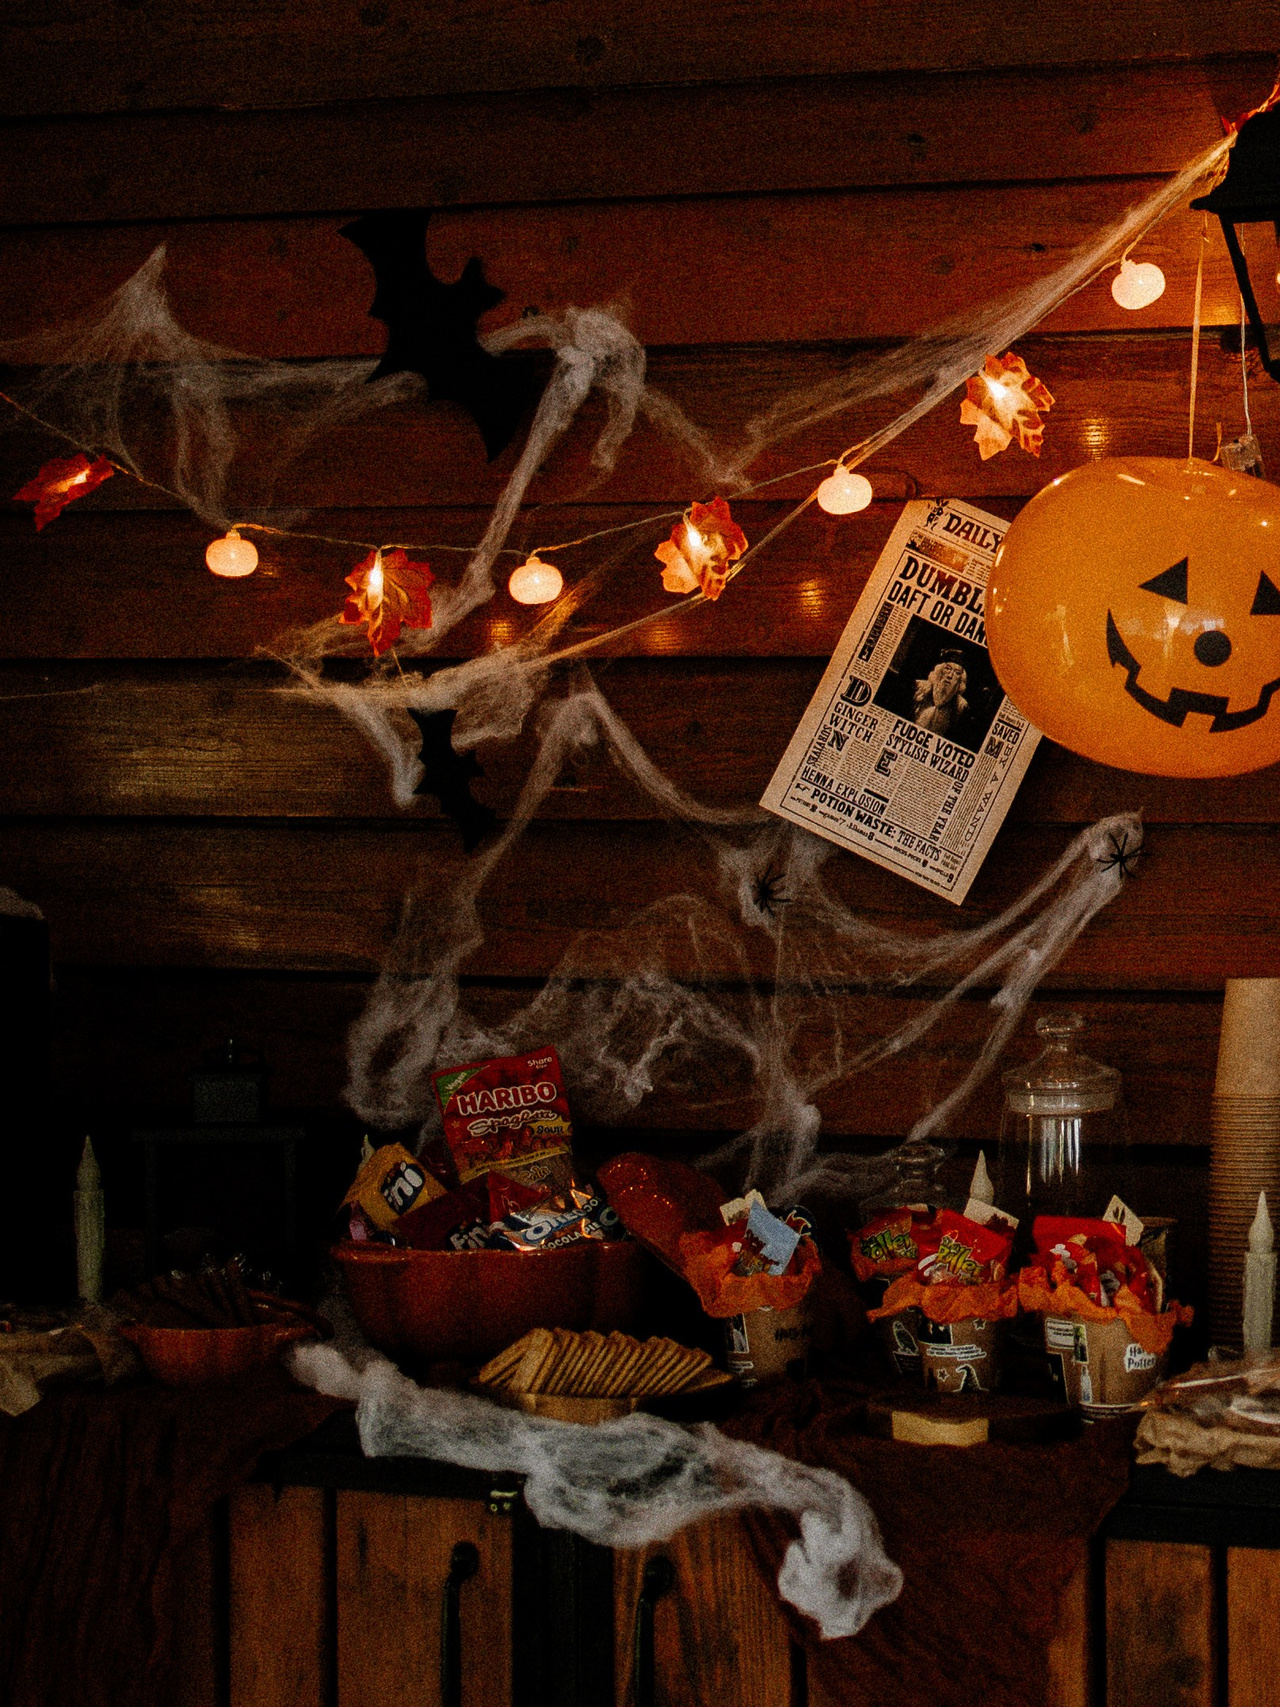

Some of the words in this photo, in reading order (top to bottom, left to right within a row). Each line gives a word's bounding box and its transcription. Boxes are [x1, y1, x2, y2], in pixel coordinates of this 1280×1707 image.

[941, 512, 1004, 554] DAILY
[898, 553, 985, 617] DUMBL
[886, 580, 931, 613] DAFT
[929, 600, 954, 627] OR
[952, 610, 988, 647] DAN
[840, 675, 871, 706] D
[829, 712, 873, 743] WITCH
[833, 701, 878, 730] GINGER
[806, 724, 832, 767] SURVIVES
[827, 729, 849, 751] N
[892, 718, 933, 748] FUDGE
[935, 738, 975, 768] VOTED
[991, 722, 1019, 744] SAVED
[874, 747, 897, 777] E
[885, 733, 930, 763] STYLISH
[929, 753, 969, 782] WIZARD
[998, 743, 1013, 769] BY
[801, 765, 834, 790] HENNA
[834, 782, 887, 815] EXPLOSION
[951, 781, 963, 794] OF
[989, 771, 998, 783] A
[940, 794, 958, 815] THE
[964, 790, 993, 841] WAND
[810, 787, 855, 817] POTION
[854, 809, 896, 838] WASTE:
[896, 829, 916, 848] THE
[913, 839, 941, 861] FACTS
[928, 815, 947, 841] YEAR
[527, 1056, 553, 1068] Share
[457, 1082, 557, 1116] HARIBO
